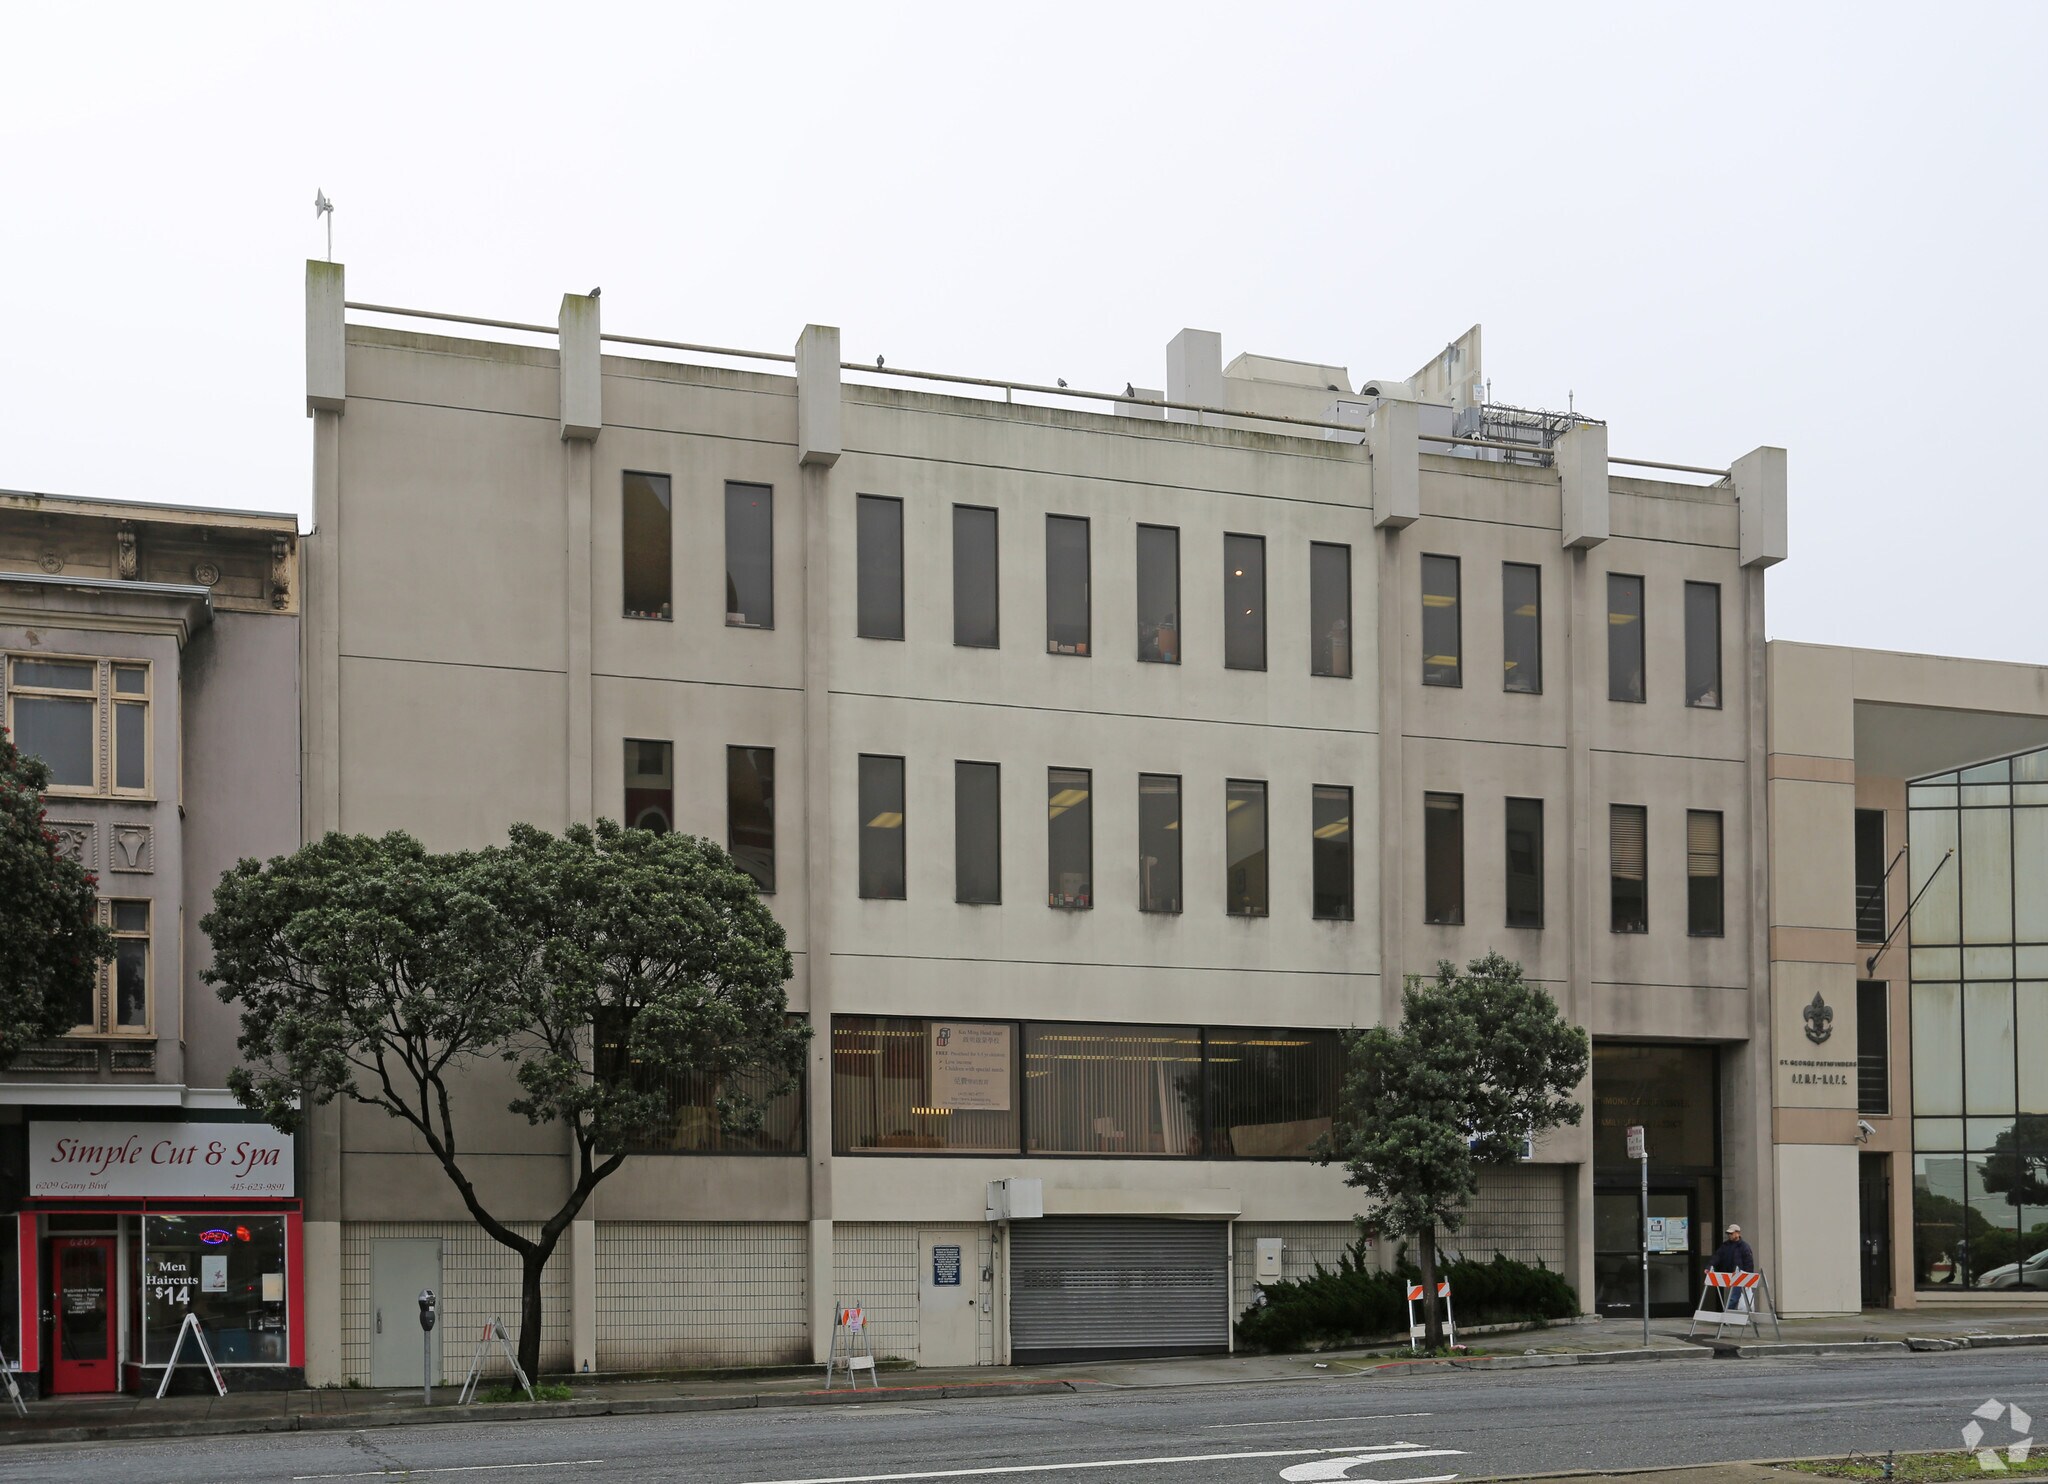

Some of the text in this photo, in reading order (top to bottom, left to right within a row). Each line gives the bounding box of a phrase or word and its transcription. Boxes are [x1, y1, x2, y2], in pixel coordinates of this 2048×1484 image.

[51, 1134, 281, 1178] Simple Cut & Spa
[35, 1181, 109, 1191] 6209 Geary Blvd
[229, 1182, 286, 1192] 415-623-9891
[199, 1231, 230, 1242] OPEN
[159, 1261, 187, 1273] Men
[146, 1274, 199, 1286] Haircuts
[155, 1286, 190, 1306] $14
